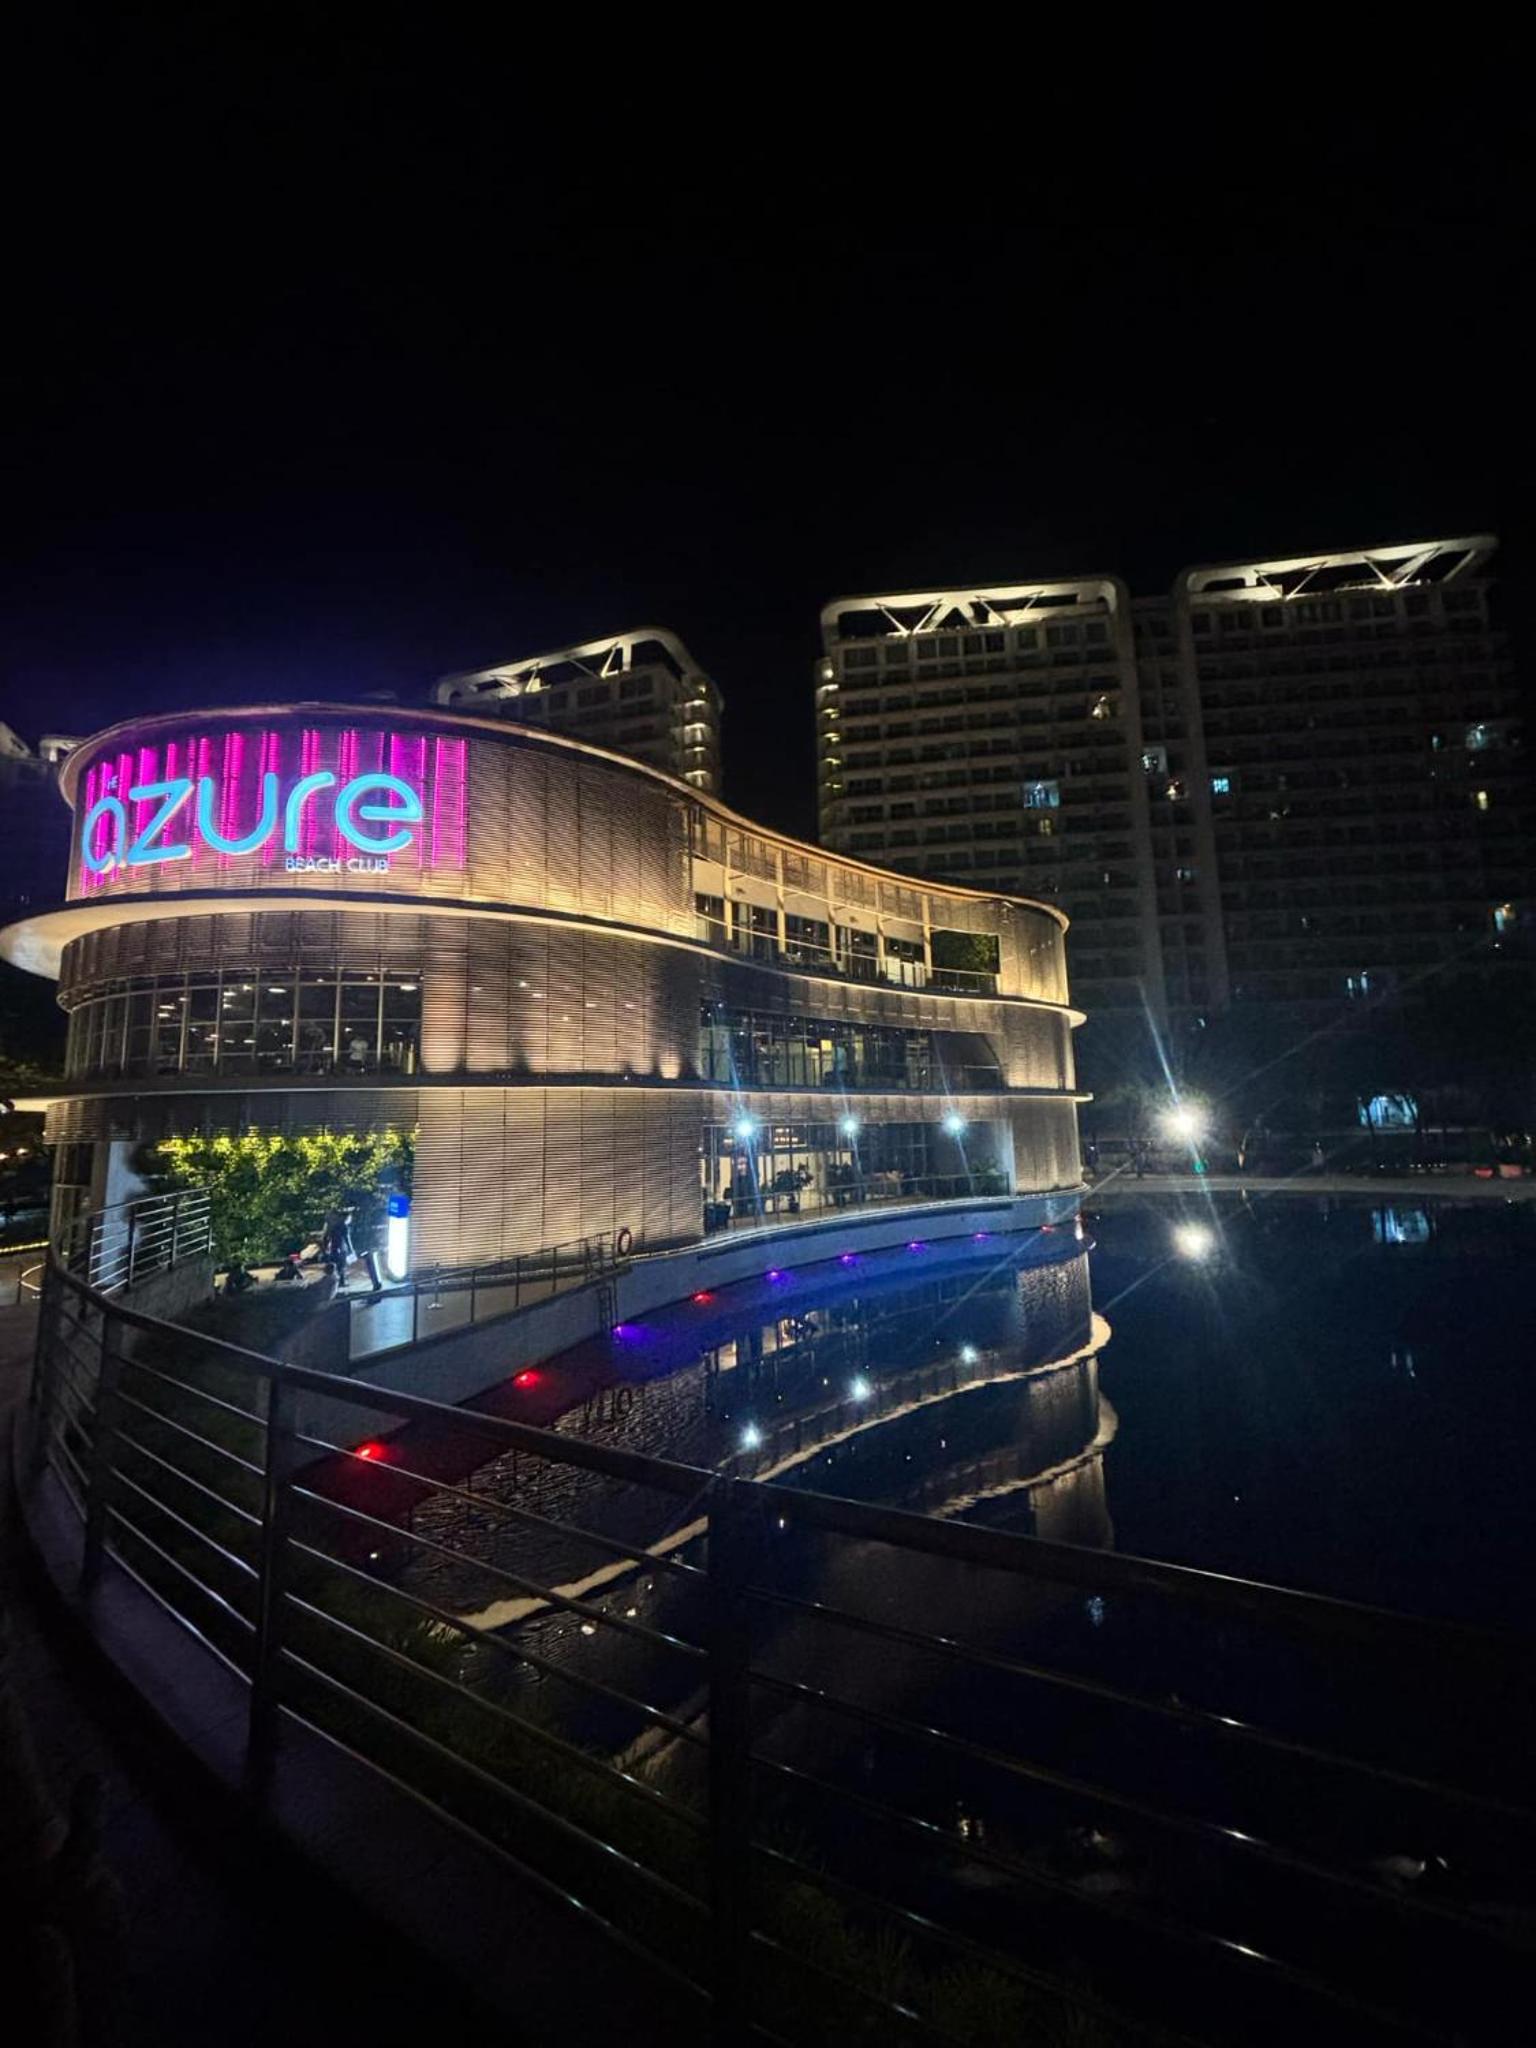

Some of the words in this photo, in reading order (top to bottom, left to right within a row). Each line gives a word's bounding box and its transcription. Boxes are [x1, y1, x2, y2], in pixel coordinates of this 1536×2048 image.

[82, 771, 423, 873] azure
[285, 856, 340, 873] BEACH
[347, 857, 389, 873] CLUB
